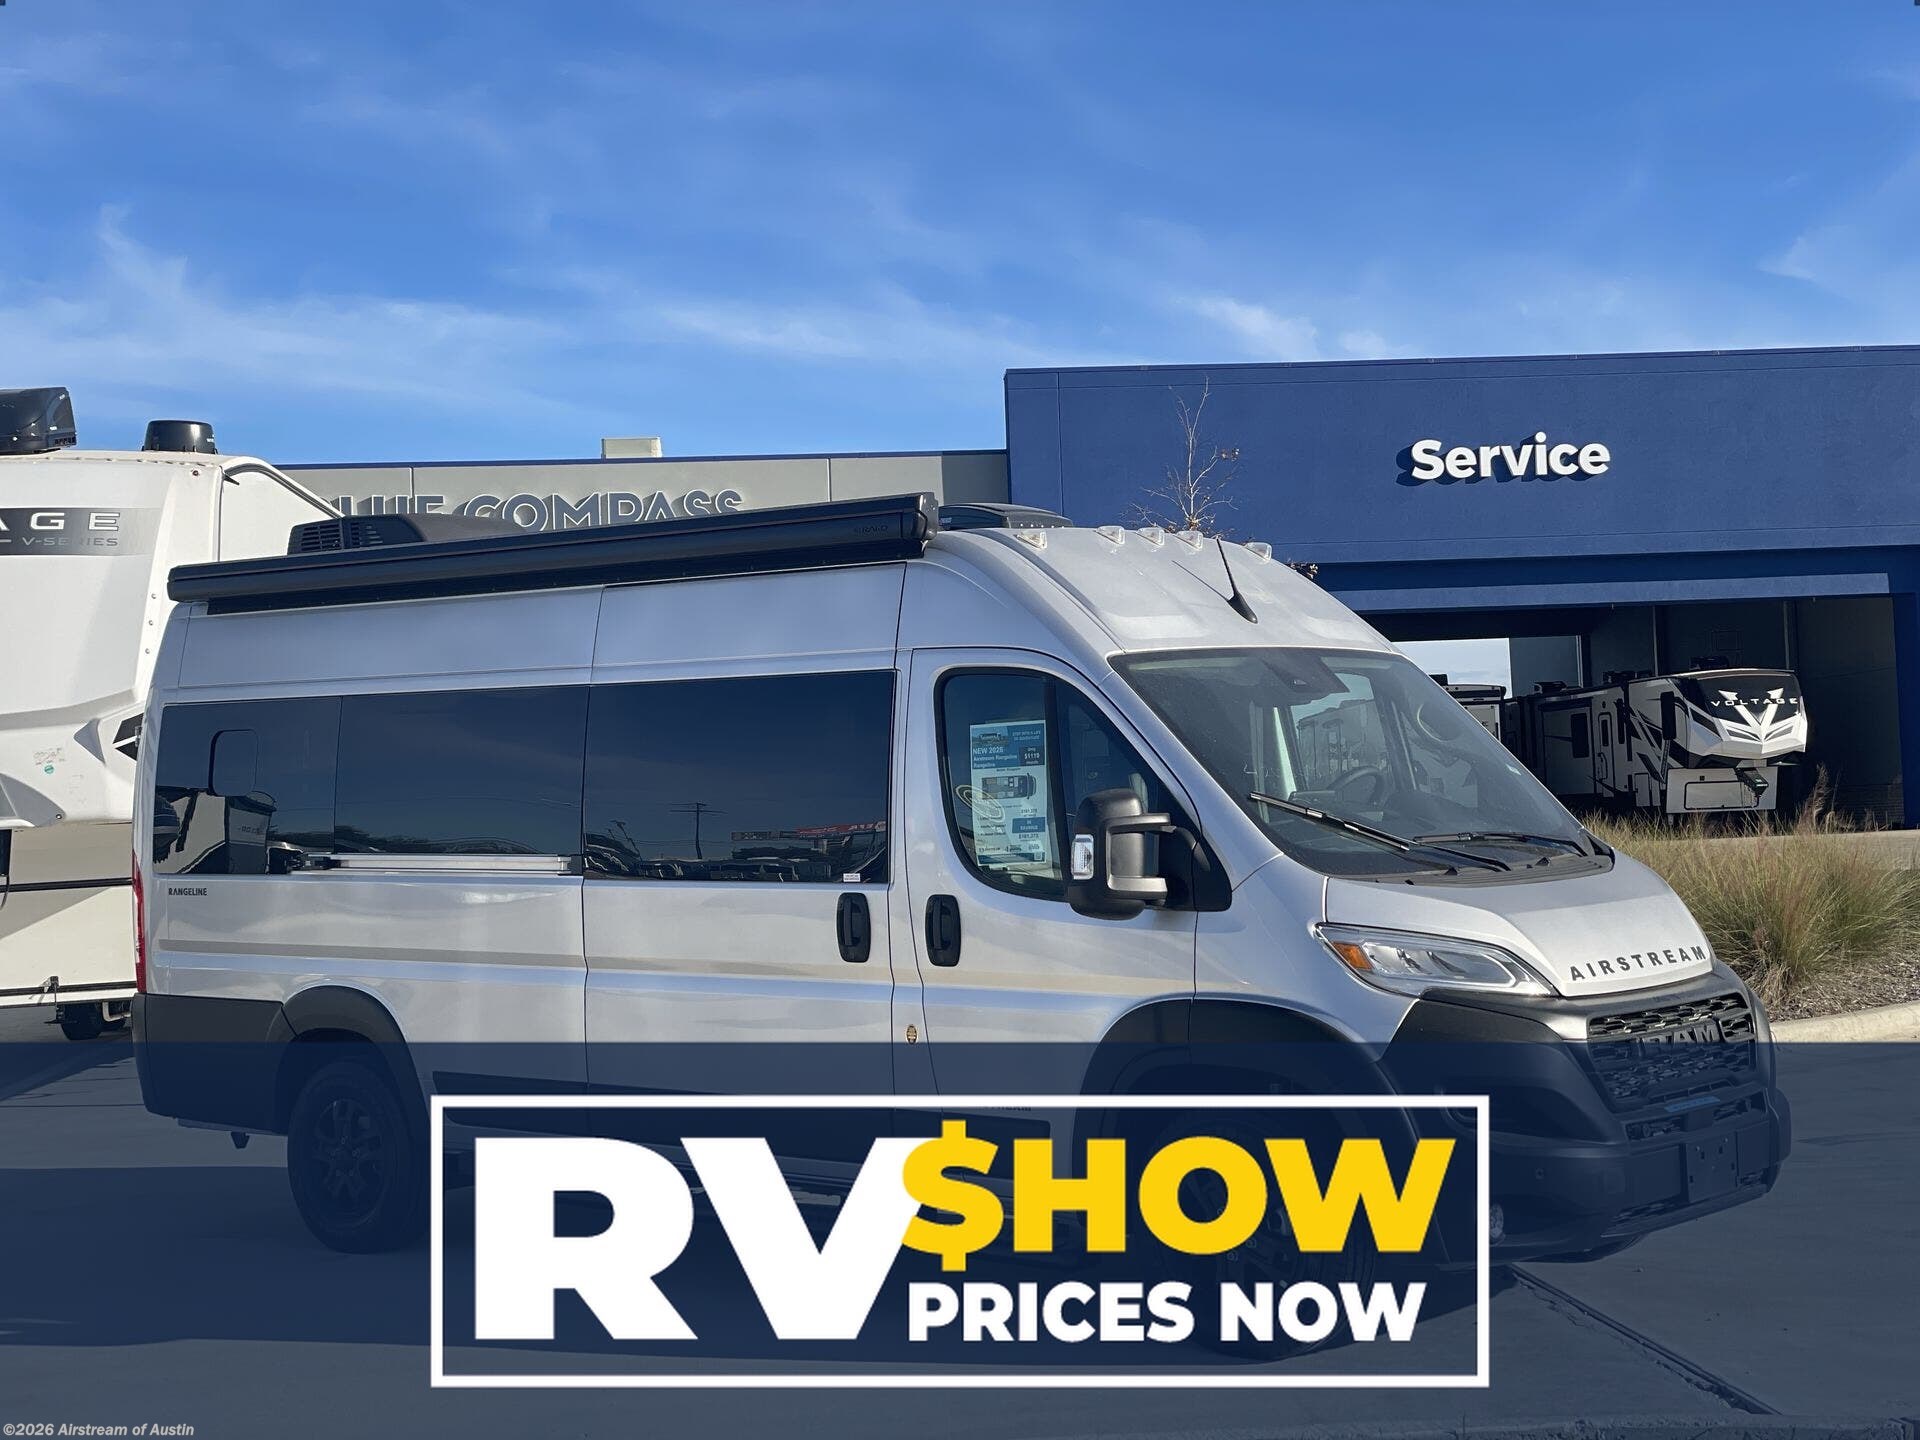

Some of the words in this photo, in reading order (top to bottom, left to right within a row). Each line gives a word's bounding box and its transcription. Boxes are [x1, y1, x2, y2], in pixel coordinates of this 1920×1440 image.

[1411, 431, 1611, 480] Service
[463, 489, 744, 534] COMPASS
[0, 512, 121, 531] GE
[22, 537, 119, 546] V-SEIES
[1711, 698, 1799, 707] VOLTAGE
[168, 887, 208, 896] RANGELINE
[1570, 946, 1706, 981] AIRSTREAM
